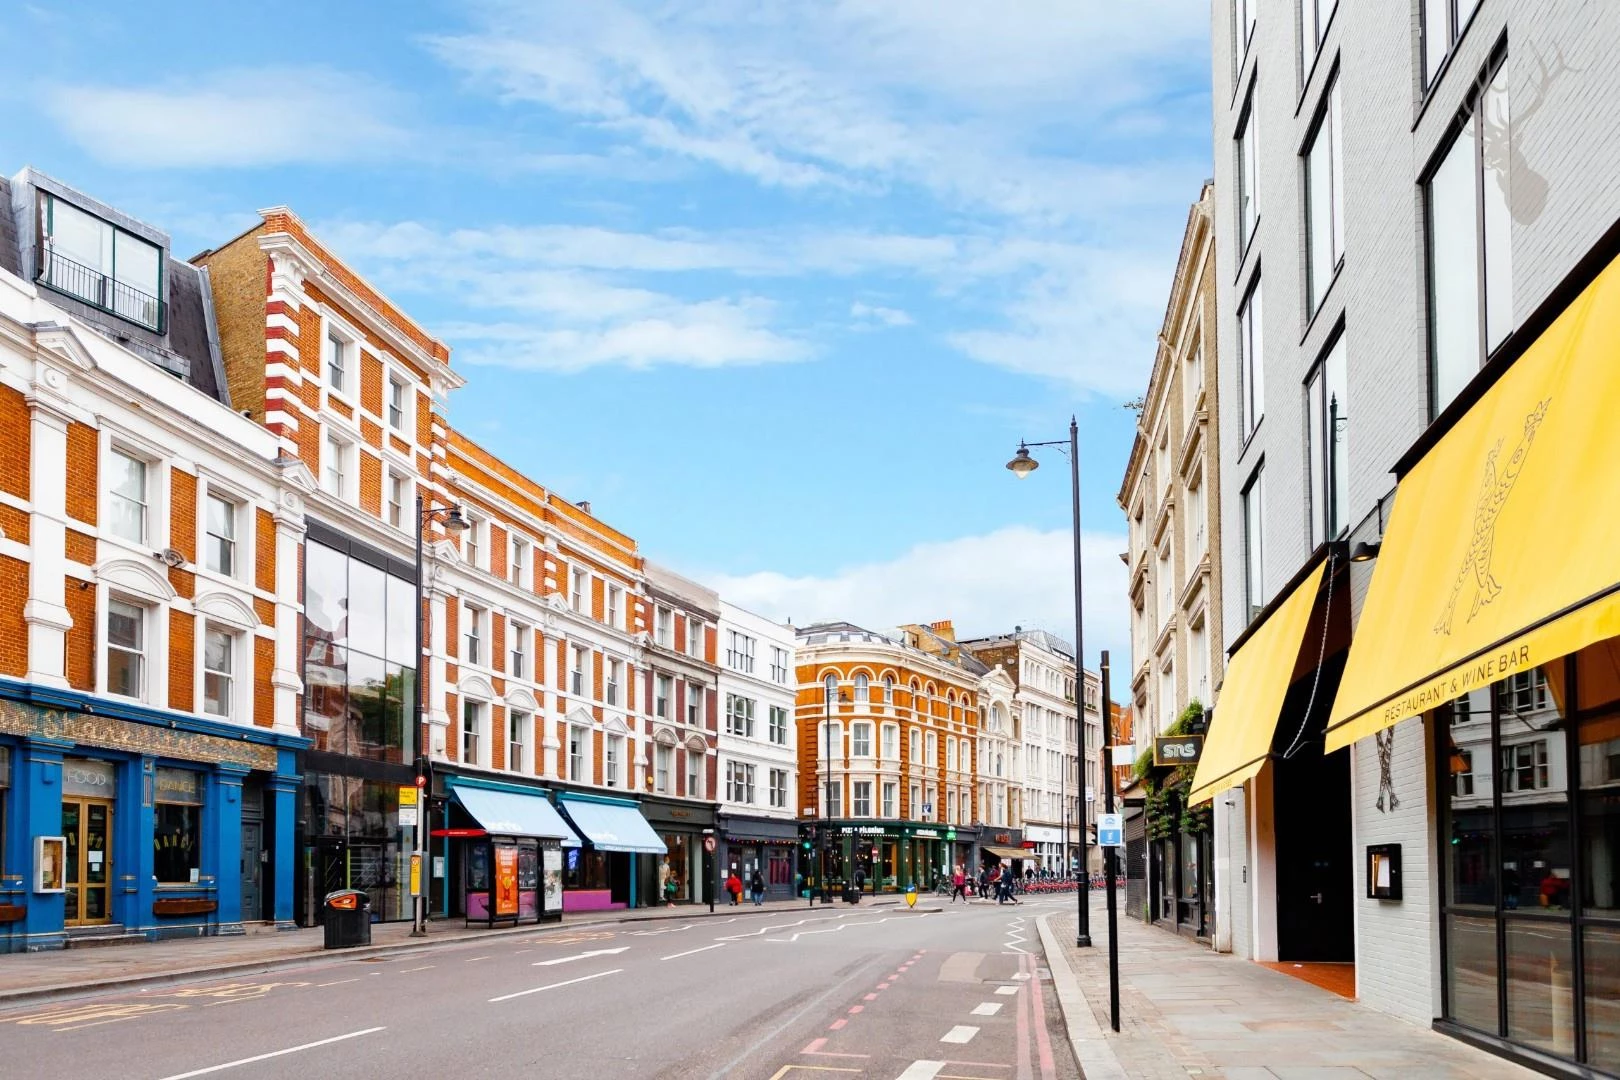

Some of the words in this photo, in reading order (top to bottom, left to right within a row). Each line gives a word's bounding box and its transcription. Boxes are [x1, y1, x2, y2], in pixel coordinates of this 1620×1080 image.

[1384, 682, 1447, 724] RESTAURANT
[1450, 678, 1458, 693] &
[1462, 659, 1495, 688] WINE
[1498, 645, 1529, 673] BAR
[67, 767, 106, 787] FOOD
[159, 780, 196, 794] DANCE
